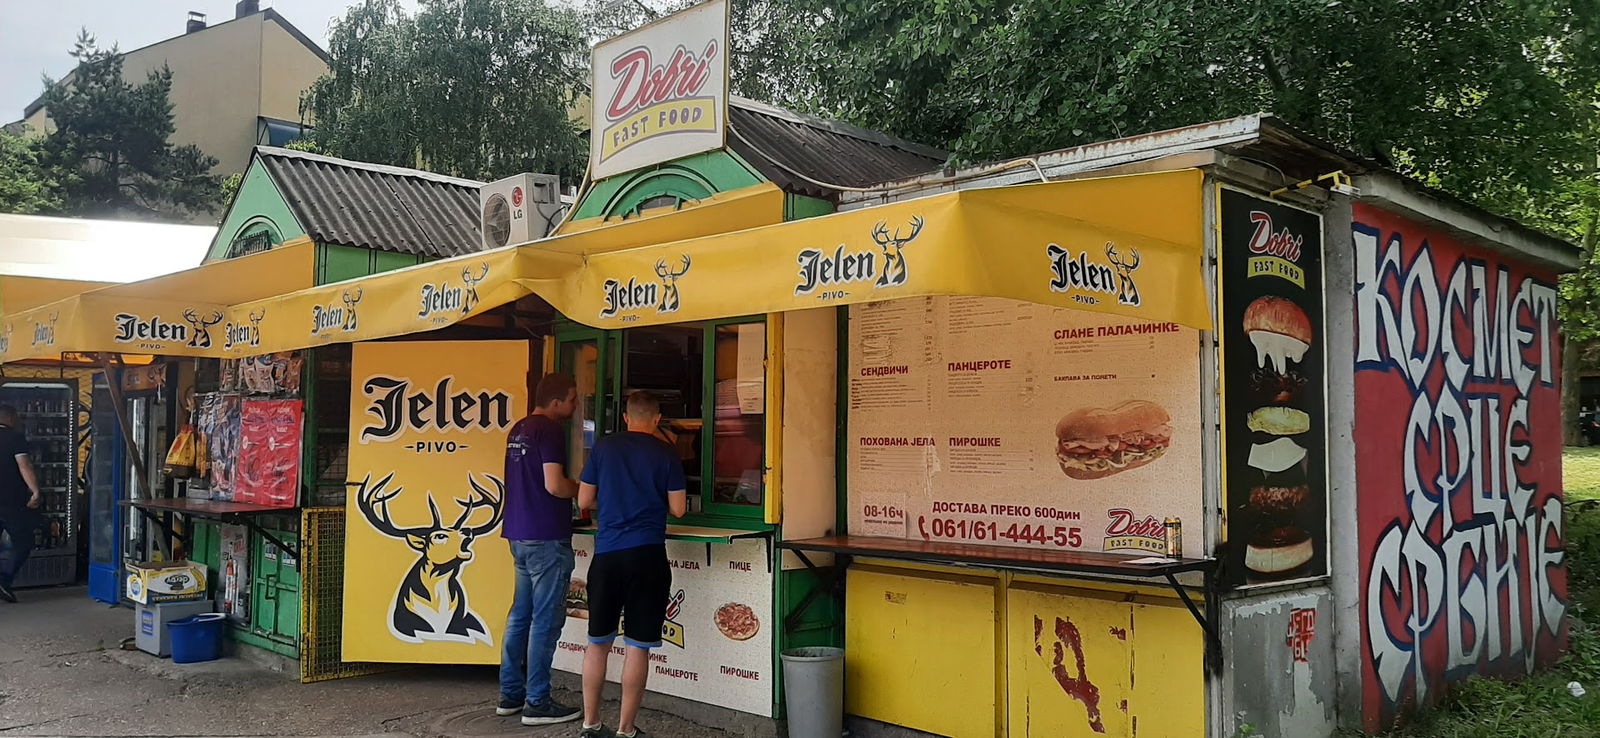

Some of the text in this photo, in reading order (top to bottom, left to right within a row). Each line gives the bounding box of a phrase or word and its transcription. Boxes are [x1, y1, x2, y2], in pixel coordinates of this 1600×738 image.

[607, 40, 717, 121] Dobri
[658, 107, 702, 128] FOOD
[513, 209, 522, 219] LG
[1249, 211, 1303, 262] Dobri
[795, 246, 874, 294] Jelen
[1047, 244, 1116, 294] Jelen
[1279, 263, 1299, 280] FOOD
[419, 281, 461, 317] Jelen
[600, 276, 656, 317] Jelen
[311, 304, 342, 333] Jelen
[1352, 223, 1558, 396] КОСМЕТ
[115, 313, 187, 341] Jelen
[225, 322, 250, 348] Jelen
[1054, 322, 1180, 340] СЛАНЕ ПАЛАЧИНКЕ
[861, 365, 909, 377] СЕНДВИЧИ
[947, 359, 1012, 372] ПАНЦЕРОТЕ
[362, 376, 511, 440] Jelen
[860, 437, 936, 447] ПОХОВАНА ЈЕЛА
[949, 437, 1001, 447] ПИРОШКЕ
[1404, 380, 1533, 537] СРЦЕ
[864, 504, 903, 519] 08-16ч
[932, 501, 1081, 521] ДОСТАВА ПРЕКО 600дин
[932, 518, 1083, 548] 061/61-444-55
[1139, 540, 1163, 550] FOOD
[680, 560, 700, 570] ЈЕЛА
[729, 560, 752, 572] ПИЦЕ
[1367, 497, 1568, 705] СРБИЈЕ
[655, 665, 699, 682] ПАНЦЕРОТЕ
[720, 665, 760, 681] ПИРОШКЕ
